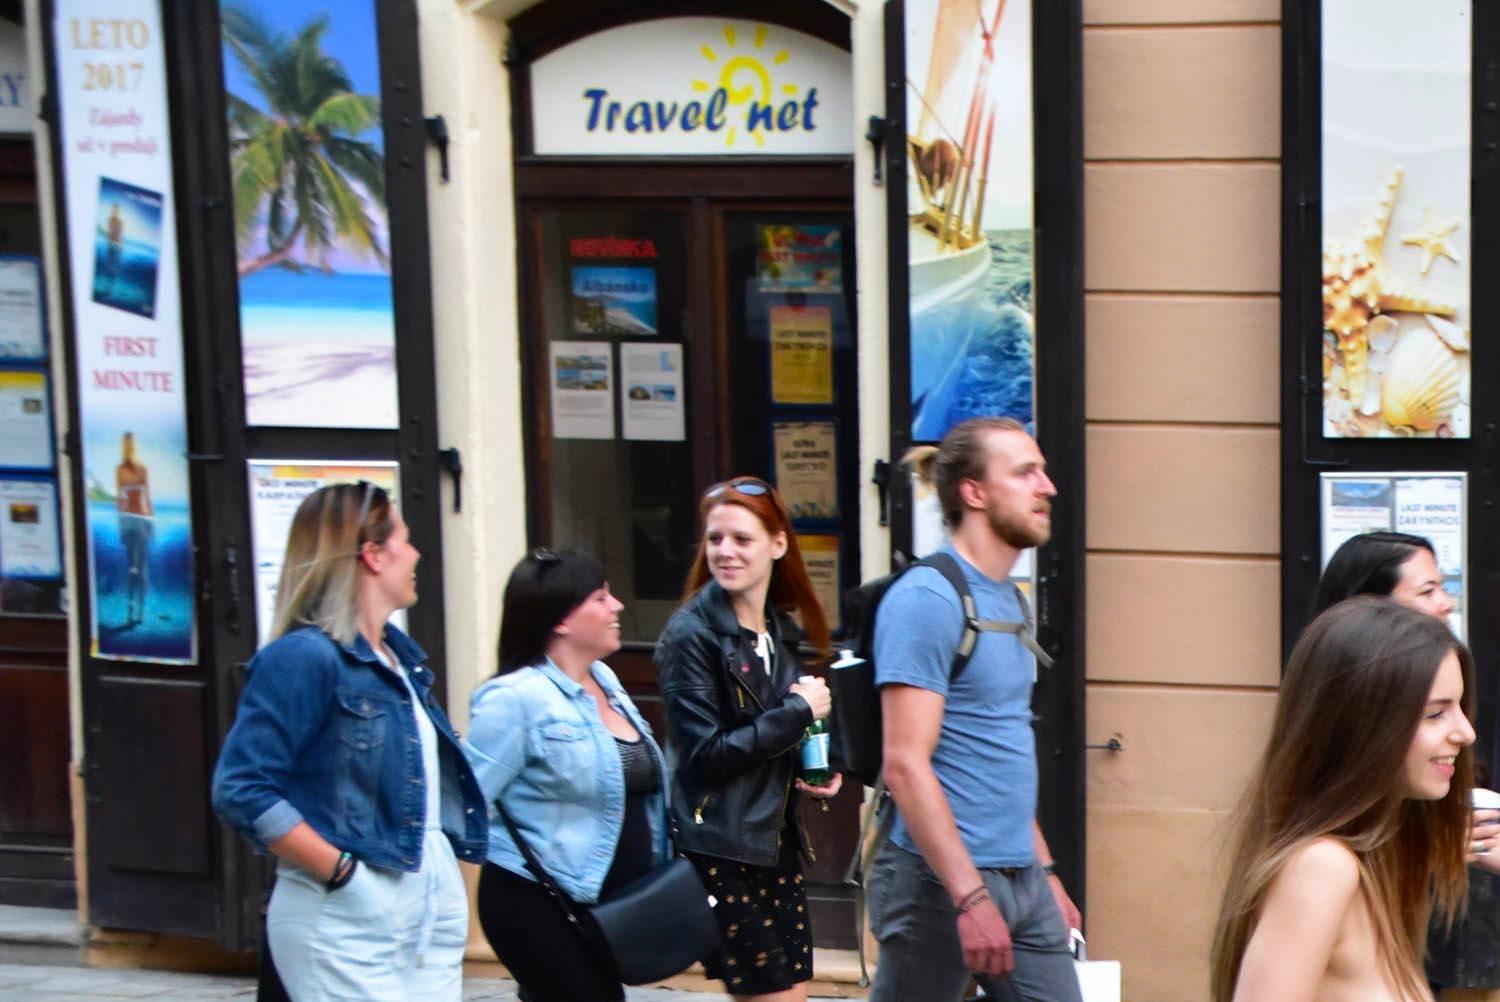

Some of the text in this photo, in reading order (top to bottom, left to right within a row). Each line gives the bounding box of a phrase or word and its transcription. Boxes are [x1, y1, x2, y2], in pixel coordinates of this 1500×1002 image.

[71, 18, 150, 50] LETO
[82, 61, 145, 91] 2017
[583, 87, 819, 132] Travel net
[103, 336, 157, 357] FIRST
[93, 369, 174, 394] MINUTE
